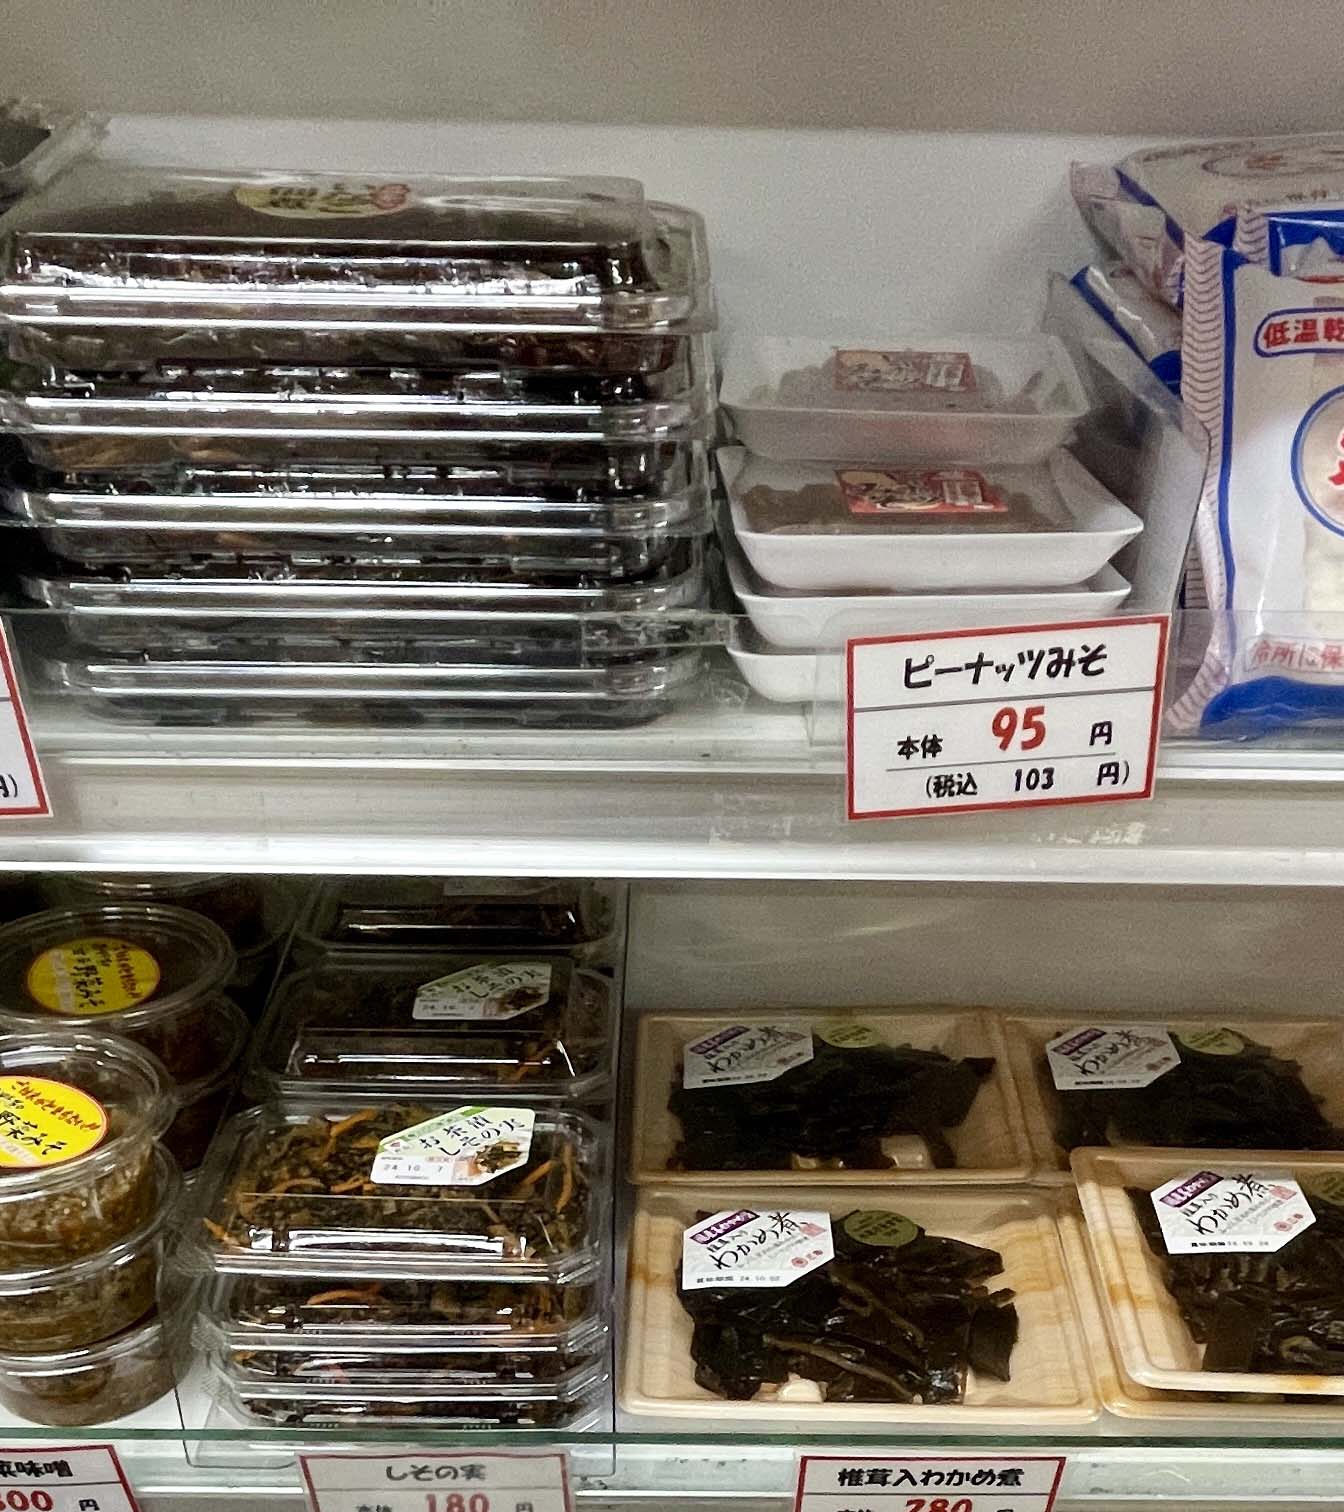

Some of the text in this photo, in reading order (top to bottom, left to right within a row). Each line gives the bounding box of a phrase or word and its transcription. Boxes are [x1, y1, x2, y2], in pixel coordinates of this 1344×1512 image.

[903, 644, 1108, 690] ピーナッツみそ
[896, 705, 1114, 759] 本体 95 円
[926, 760, 1130, 798] (税込 103 円)
[385, 1463, 489, 1483] しその実
[836, 1467, 1026, 1489] 椎茸入わかめ煮
[77, 1498, 101, 1512] 円
